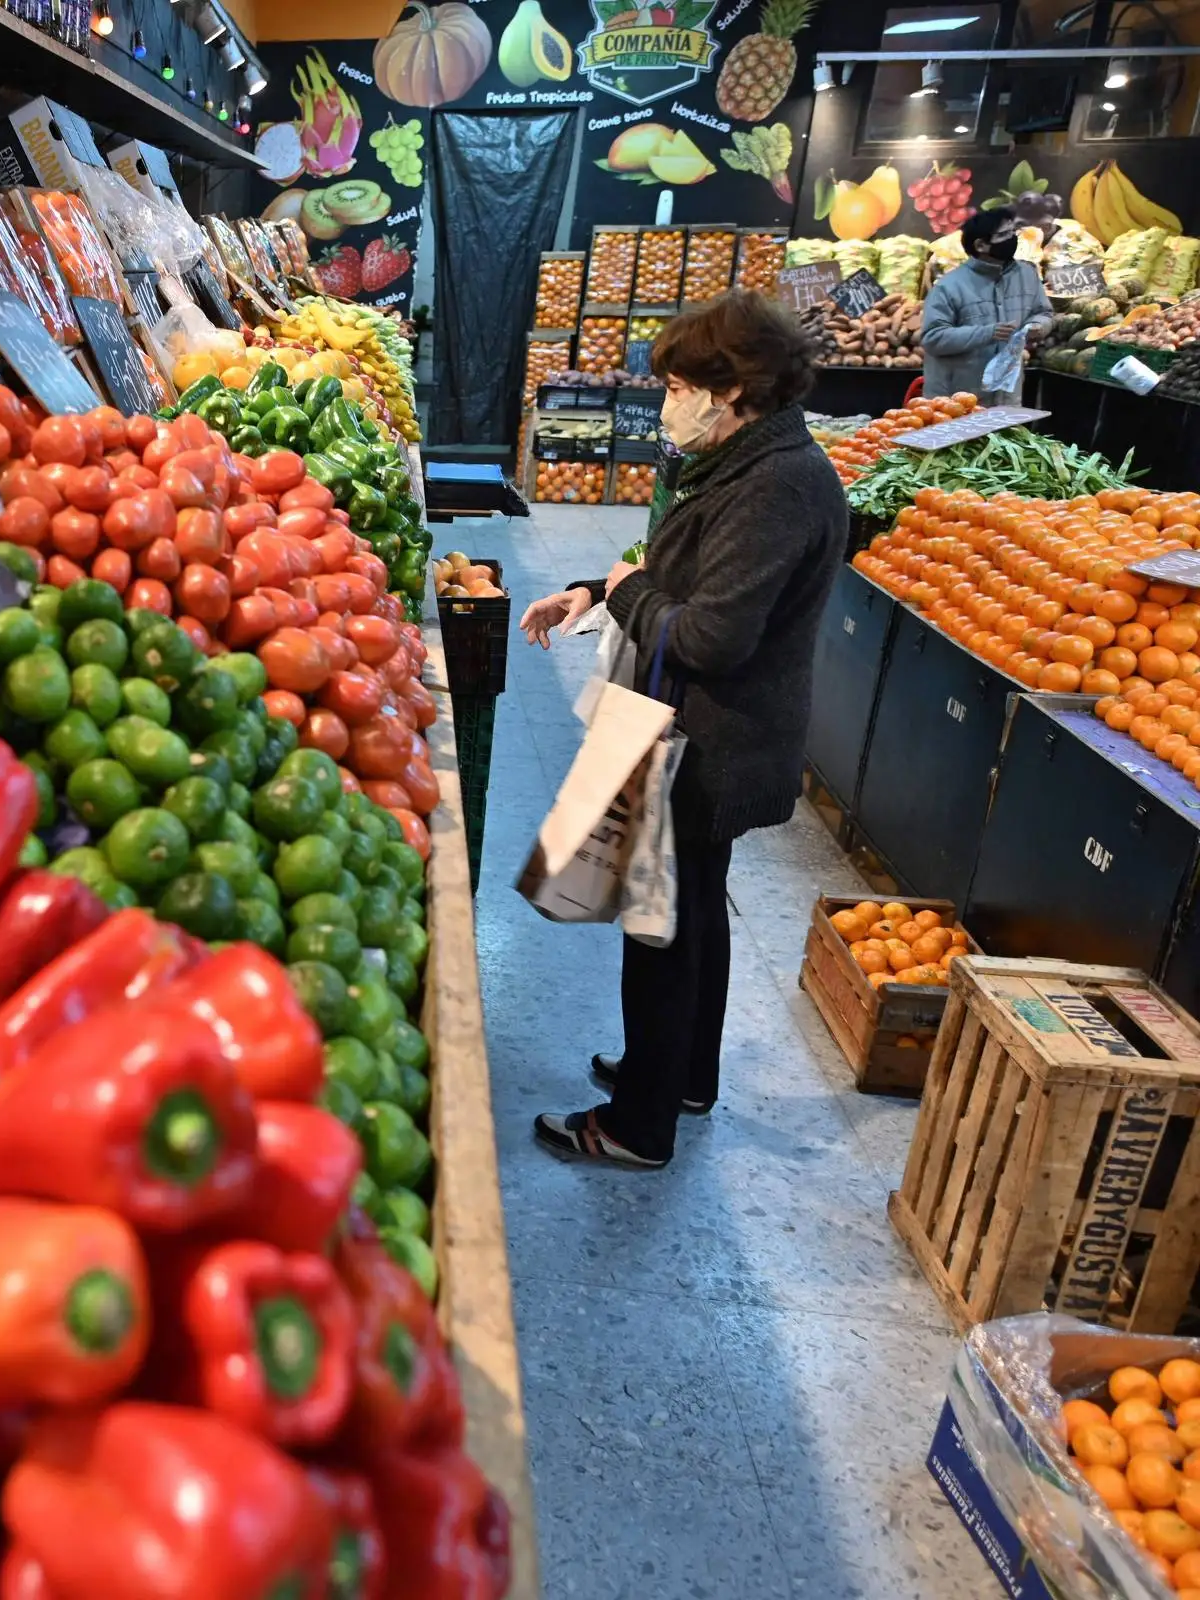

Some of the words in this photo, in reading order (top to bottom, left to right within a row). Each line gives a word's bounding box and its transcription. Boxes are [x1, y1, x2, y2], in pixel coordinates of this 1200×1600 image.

[603, 28, 691, 51] COMPAÑÍA
[619, 54, 633, 65] DE
[635, 54, 673, 65] FRUTAS
[337, 62, 373, 85] Fresco
[486, 92, 526, 104] Frutas
[529, 90, 594, 104] Tropicales
[588, 115, 621, 131] Come
[624, 108, 653, 123] sano
[670, 101, 732, 133] Hortalizas
[0, 146, 25, 185] EXTRA
[386, 206, 418, 226] Salud
[843, 616, 856, 635] CDF
[946, 696, 967, 722] CDF
[1083, 836, 1113, 872] CDF
[931, 1455, 974, 1525] Plantains
[975, 1523, 1022, 1598] Premium
